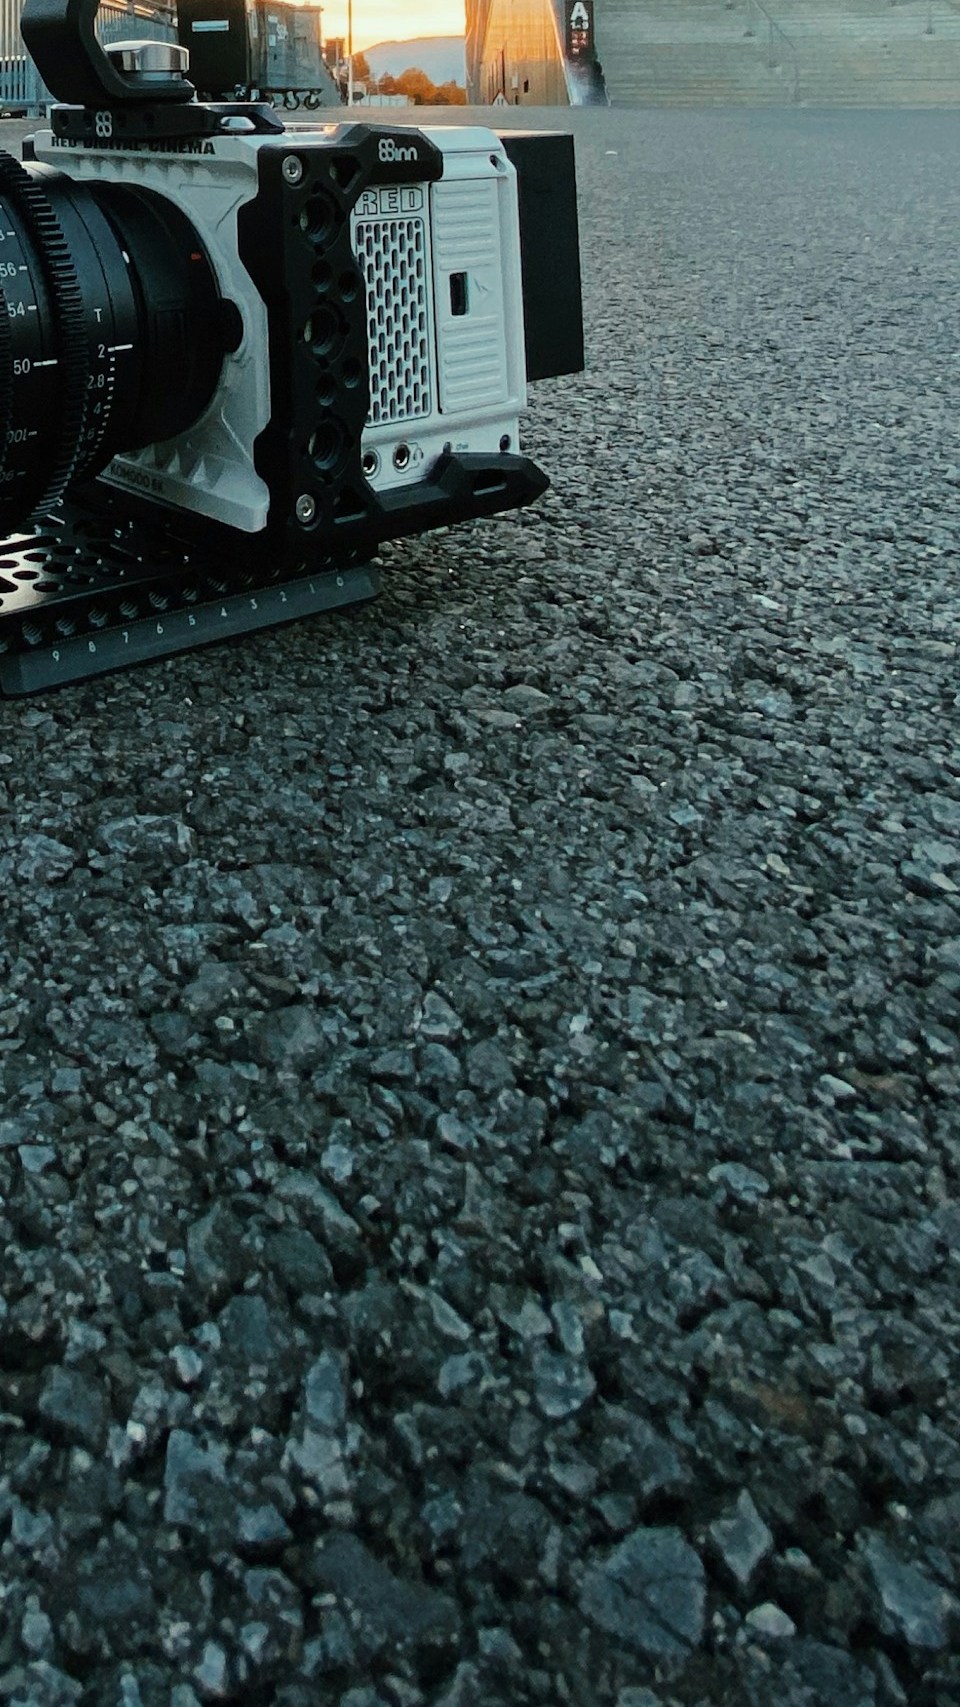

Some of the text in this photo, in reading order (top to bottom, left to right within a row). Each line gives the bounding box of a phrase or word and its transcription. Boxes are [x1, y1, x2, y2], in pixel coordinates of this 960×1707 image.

[570, 1, 589, 21] A
[354, 186, 424, 216] RED
[7, 301, 26, 318] 54
[93, 308, 102, 323] T
[97, 343, 106, 359] 2
[13, 358, 31, 375] 50
[87, 373, 105, 390] 2.8
[92, 401, 102, 415] 4
[109, 463, 150, 489] KOMODO
[52, 650, 60, 662] 9
[88, 640, 96, 653] 8
[122, 631, 129, 644] 7
[156, 622, 164, 635] 6
[188, 614, 196, 626] 5
[249, 598, 258, 610] 3
[279, 590, 287, 603] 2
[336, 576, 344, 587] 0
